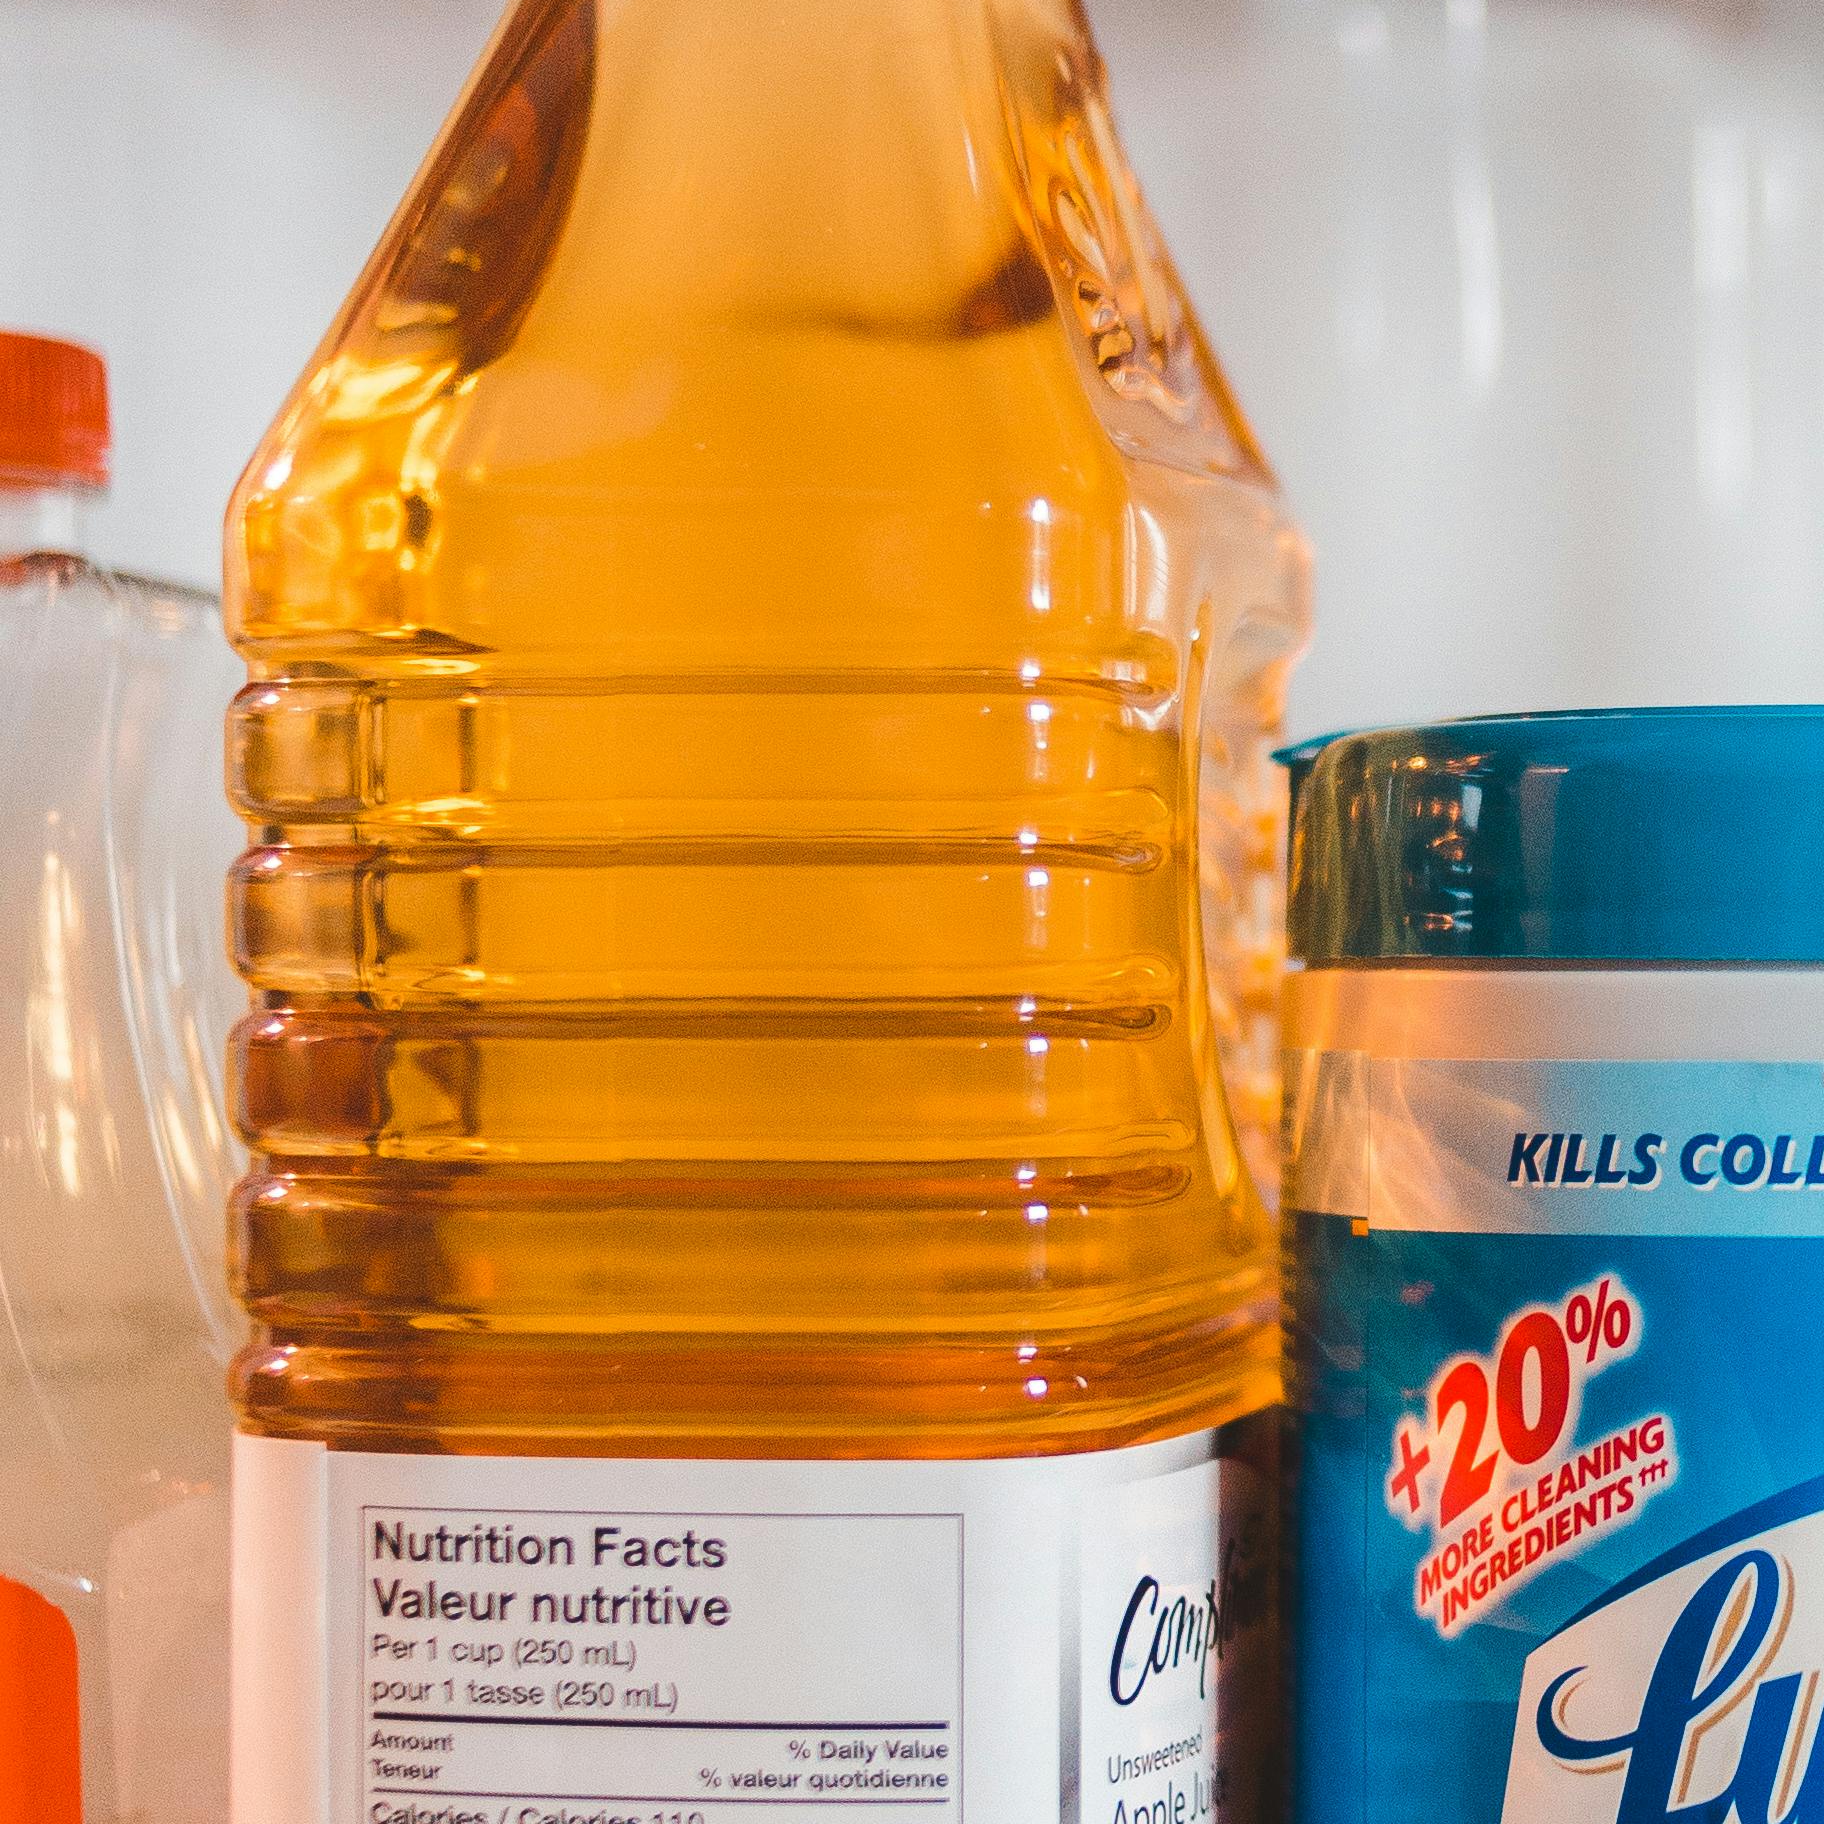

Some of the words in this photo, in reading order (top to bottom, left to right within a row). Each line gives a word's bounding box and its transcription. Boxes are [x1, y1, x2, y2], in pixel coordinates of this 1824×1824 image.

[1507, 1132, 1662, 1186] KILLS
[1391, 1278, 1631, 1529] +20%
[1420, 1513, 1494, 1607] MORE
[1501, 1416, 1665, 1533] CLEANING
[373, 1520, 576, 1565] Nutrition
[593, 1526, 728, 1568] Facts
[373, 1577, 517, 1621] Valeur
[532, 1585, 733, 1626] nutritive
[371, 1632, 420, 1660] Per
[426, 1635, 439, 1661] 1
[449, 1639, 503, 1668] cup
[513, 1637, 574, 1670] (250
[582, 1639, 638, 1671] mL)
[371, 1679, 433, 1704] pour
[442, 1677, 455, 1702] 1
[466, 1679, 546, 1706] tasse
[553, 1679, 615, 1713] (250
[624, 1681, 679, 1714] mL)
[371, 1729, 454, 1752] Amount
[789, 1739, 812, 1761] %
[818, 1739, 878, 1764] Daily
[883, 1739, 950, 1761] Value
[371, 1758, 443, 1780] Teneur
[699, 1768, 723, 1789] %
[730, 1768, 802, 1788] valeur
[808, 1769, 950, 1793] quotidienne
